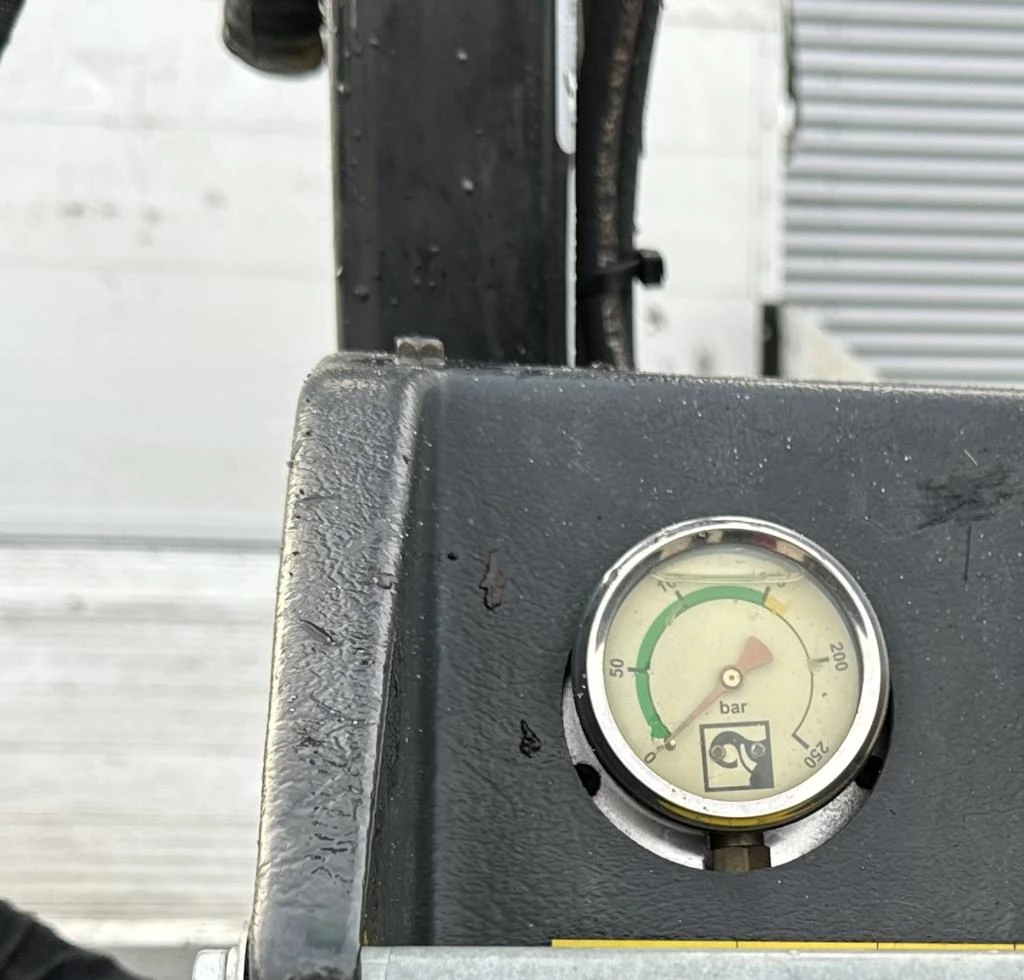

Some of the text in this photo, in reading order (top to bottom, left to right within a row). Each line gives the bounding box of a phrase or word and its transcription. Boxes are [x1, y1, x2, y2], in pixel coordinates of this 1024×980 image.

[829, 642, 850, 673] 200
[610, 658, 625, 679] 50
[719, 700, 748, 715] bar
[644, 752, 656, 764] 0
[804, 740, 829, 768] 250
